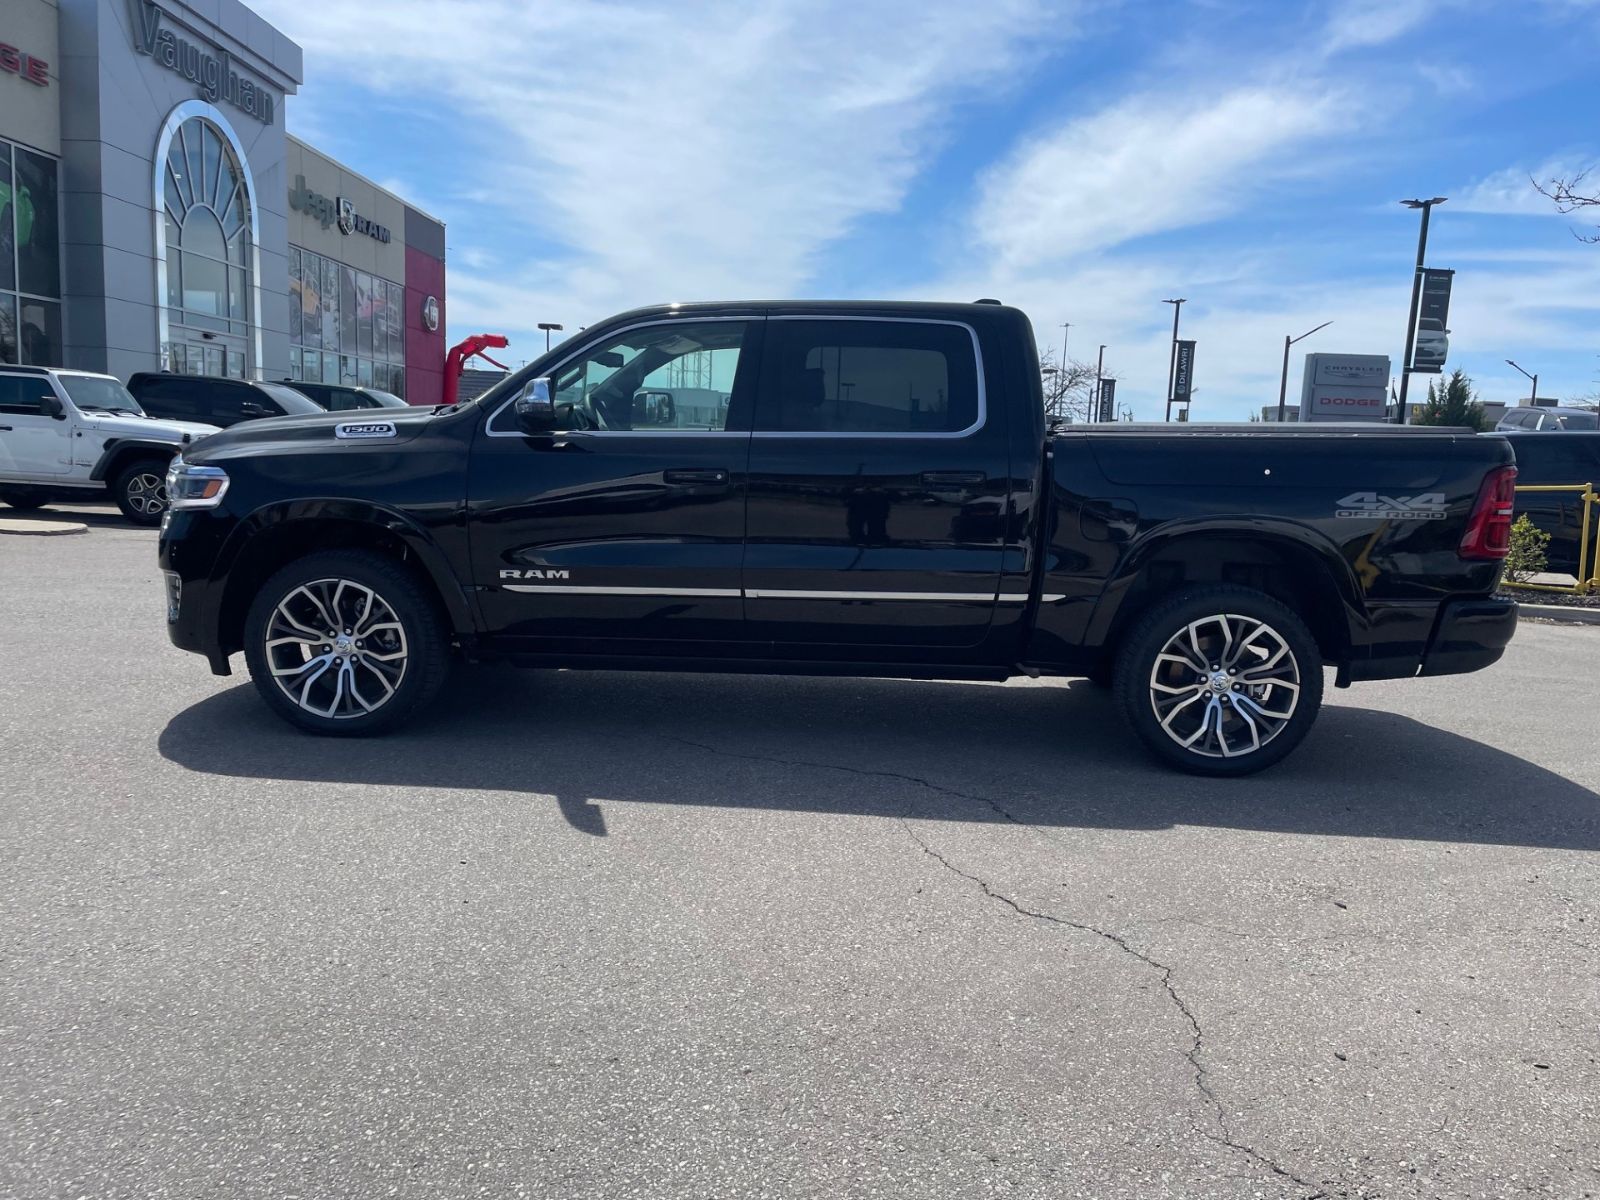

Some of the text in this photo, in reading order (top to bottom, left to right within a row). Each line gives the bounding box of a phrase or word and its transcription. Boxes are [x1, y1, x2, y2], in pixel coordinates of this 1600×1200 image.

[128, 0, 274, 125] Vaughan
[354, 214, 391, 244] RAM
[1178, 347, 1189, 385] DILAWRI
[1320, 398, 1381, 406] DODGE
[344, 425, 388, 433] 1500
[1337, 511, 1447, 519] OFF ROAD
[499, 569, 569, 579] RAM
